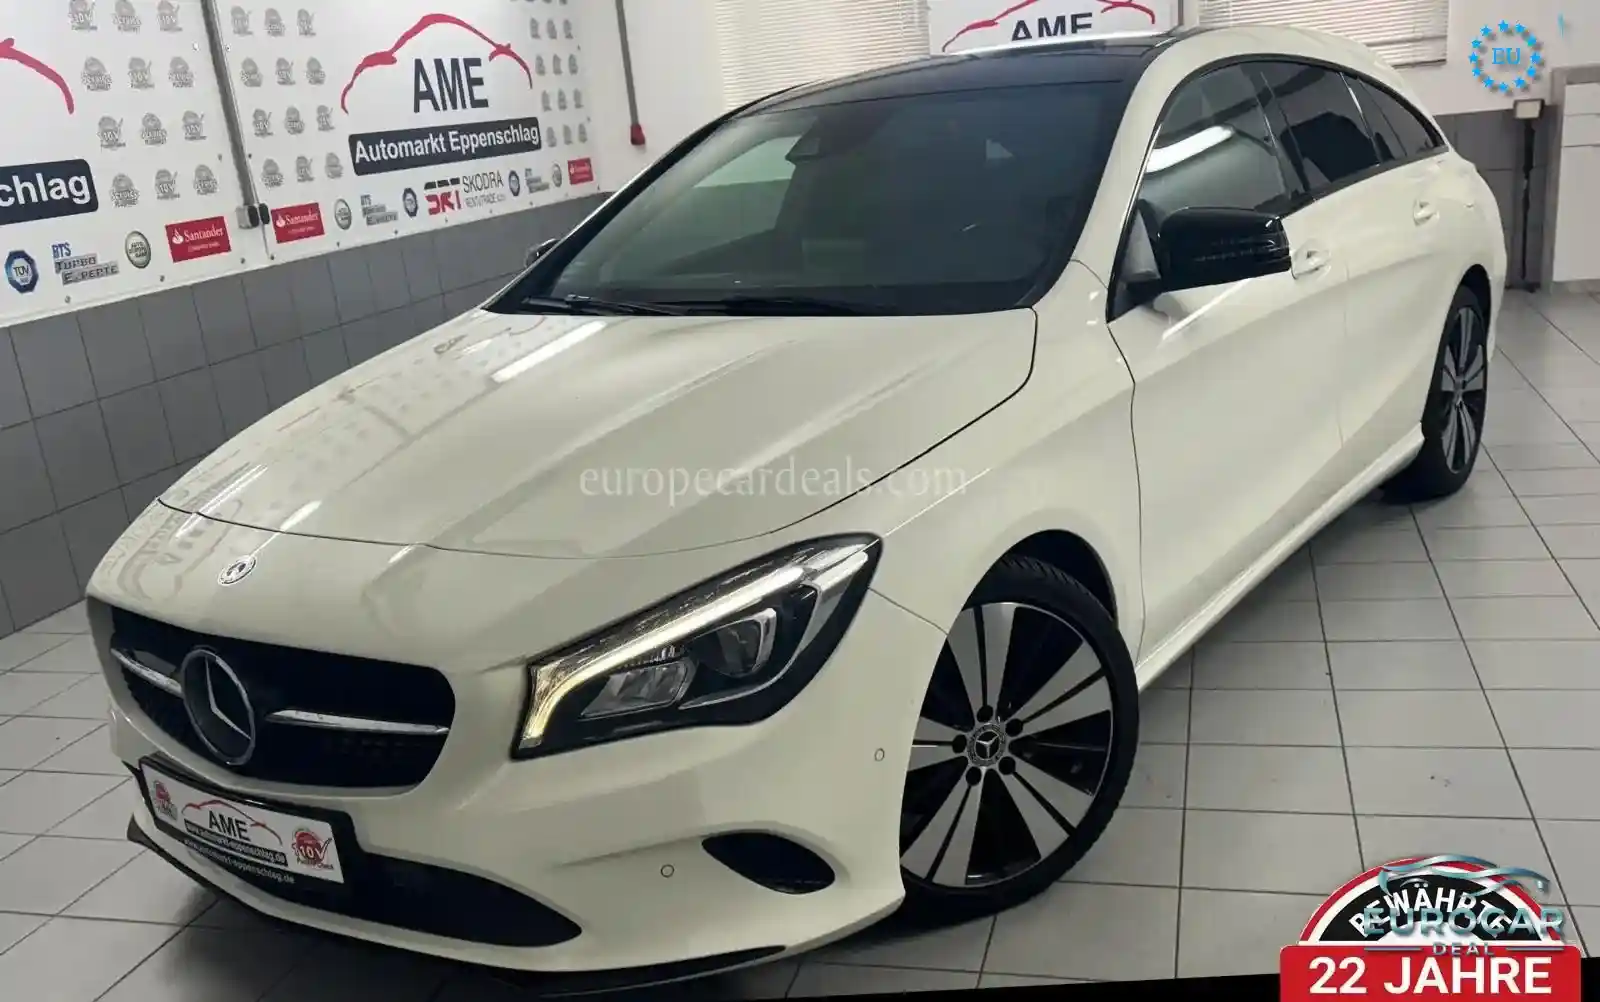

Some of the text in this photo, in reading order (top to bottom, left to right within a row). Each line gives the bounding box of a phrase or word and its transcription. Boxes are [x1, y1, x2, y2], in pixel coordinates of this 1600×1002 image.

[413, 57, 490, 114] AME
[354, 121, 541, 164] Automarkt Eppenschlag
[285, 209, 319, 226] Santander
[184, 224, 224, 242] Santander
[52, 243, 72, 259] BTS
[208, 810, 252, 842] AME
